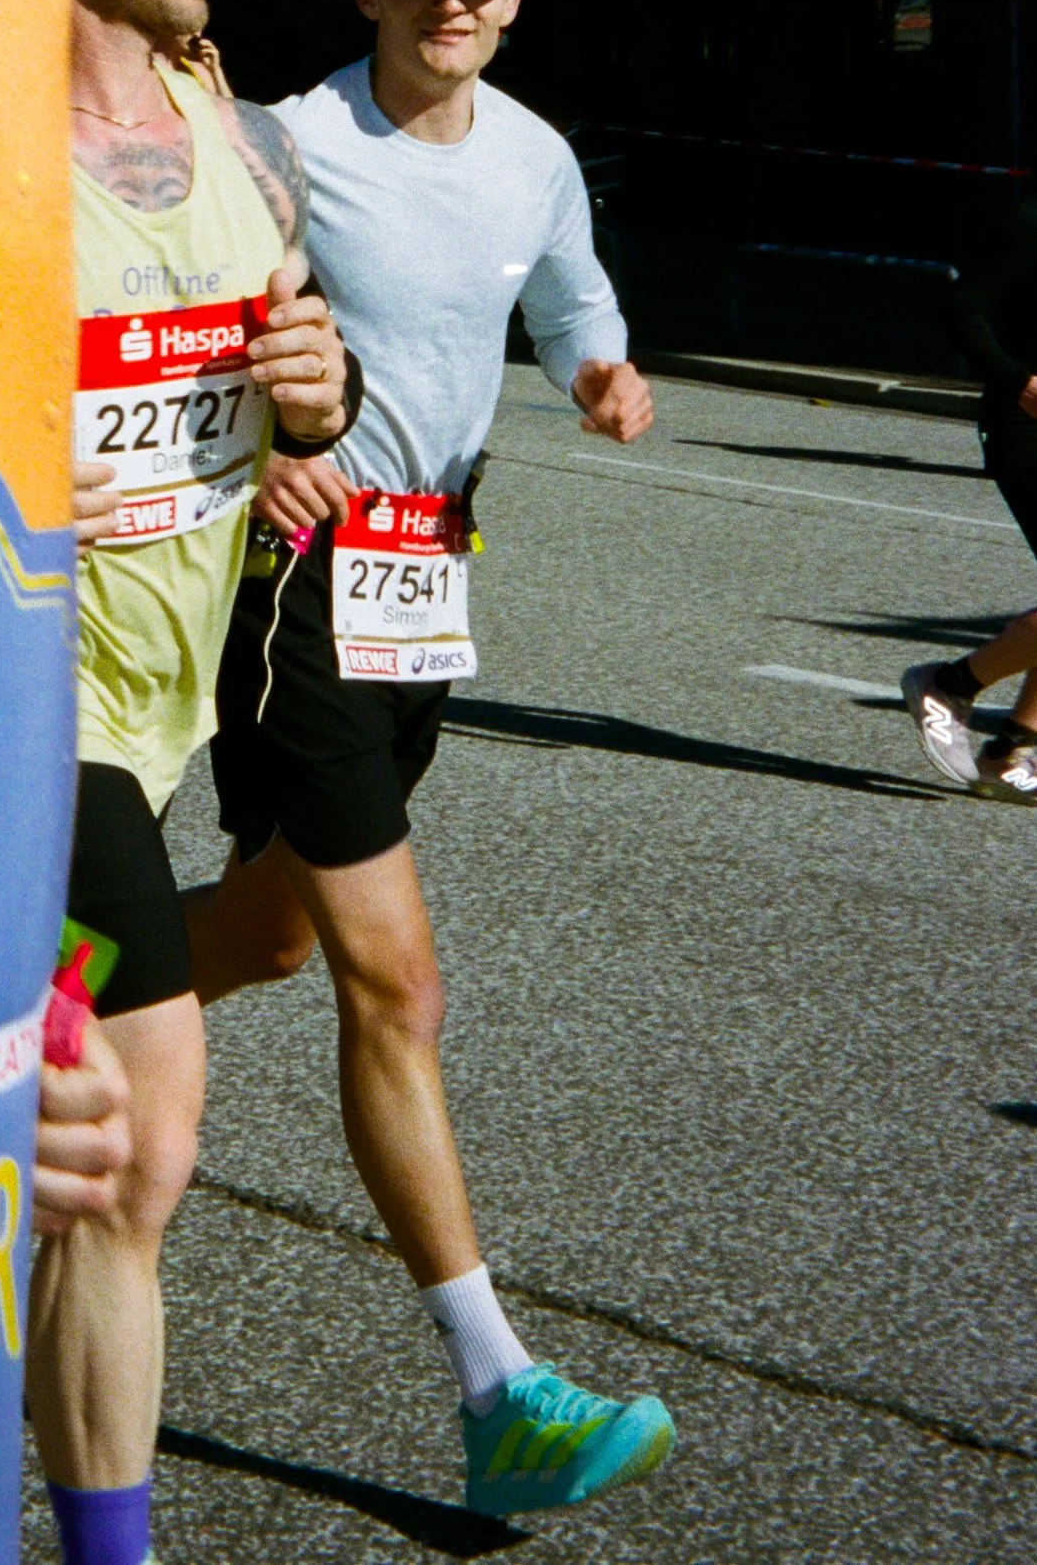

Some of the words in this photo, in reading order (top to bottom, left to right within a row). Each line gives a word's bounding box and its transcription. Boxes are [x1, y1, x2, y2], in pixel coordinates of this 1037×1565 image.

[122, 266, 220, 297] Offline
[159, 323, 245, 358] Haspa
[95, 384, 246, 454] 22727
[115, 499, 174, 534] EWE
[349, 558, 450, 605] 27541
[383, 605, 429, 626] Simon
[349, 649, 396, 674] REWE
[428, 651, 467, 671] asics
